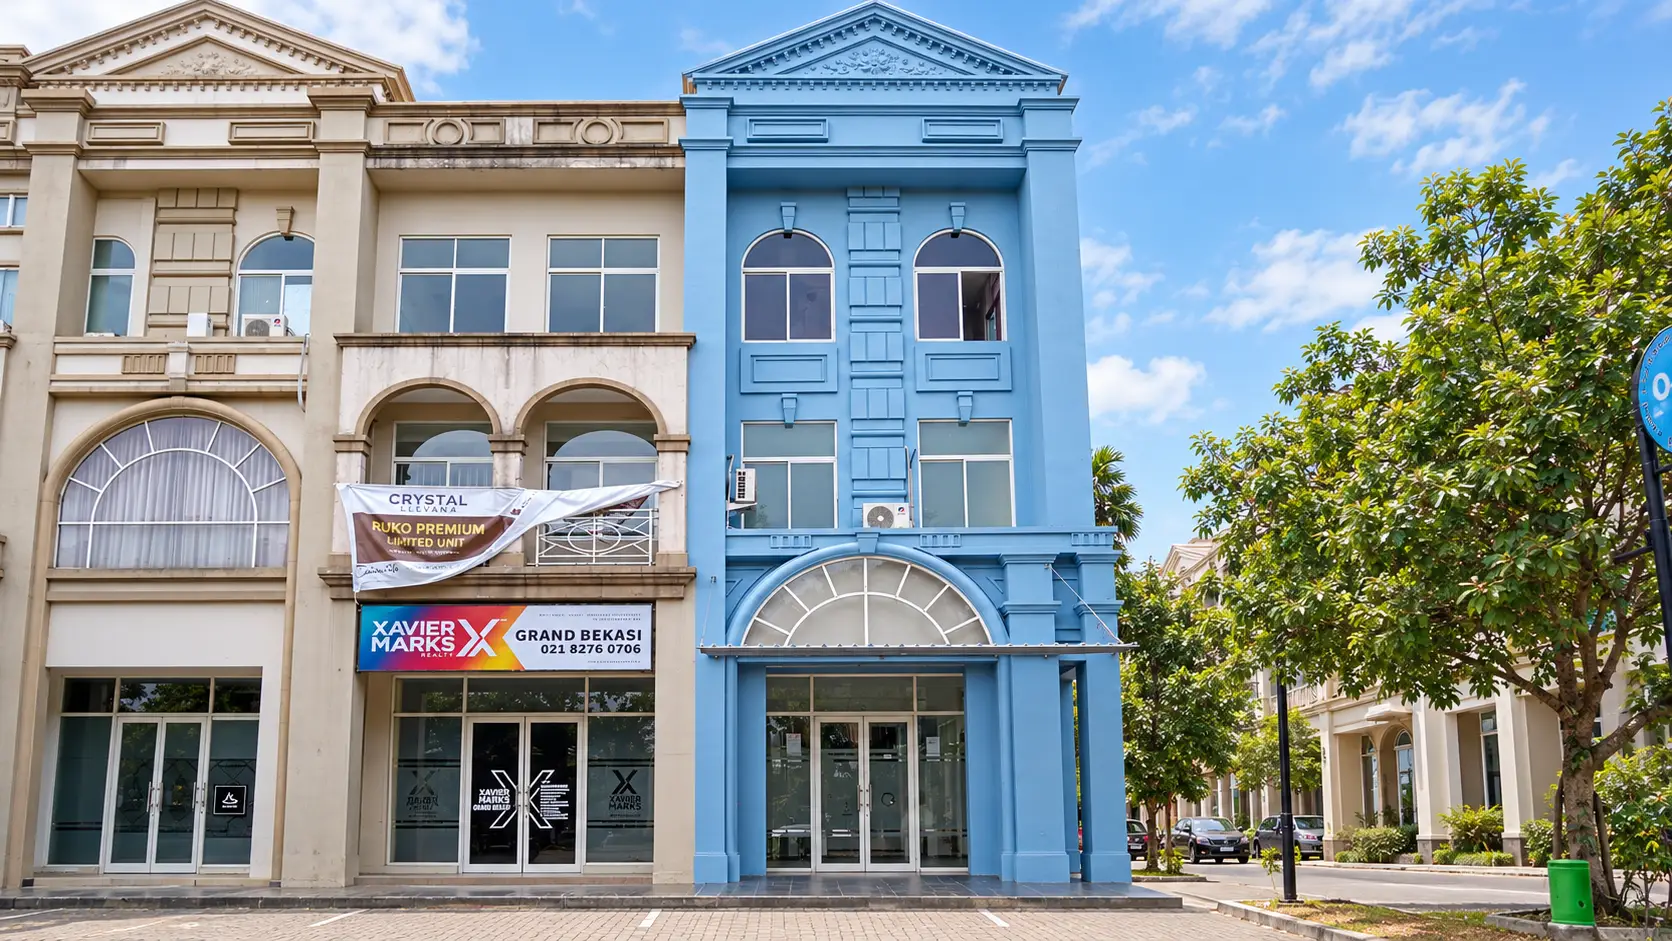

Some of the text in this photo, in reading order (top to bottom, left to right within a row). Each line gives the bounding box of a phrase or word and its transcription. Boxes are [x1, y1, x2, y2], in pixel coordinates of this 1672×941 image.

[389, 493, 468, 506] CRYSTAL
[371, 520, 485, 535] RUKO PREMIUM
[387, 536, 465, 548] LIMITED UNIT
[371, 620, 455, 636] XAVIER
[515, 629, 642, 642] GRAND BEKASI
[371, 636, 455, 652] MARKS
[540, 644, 641, 654] 021 8276 0706
